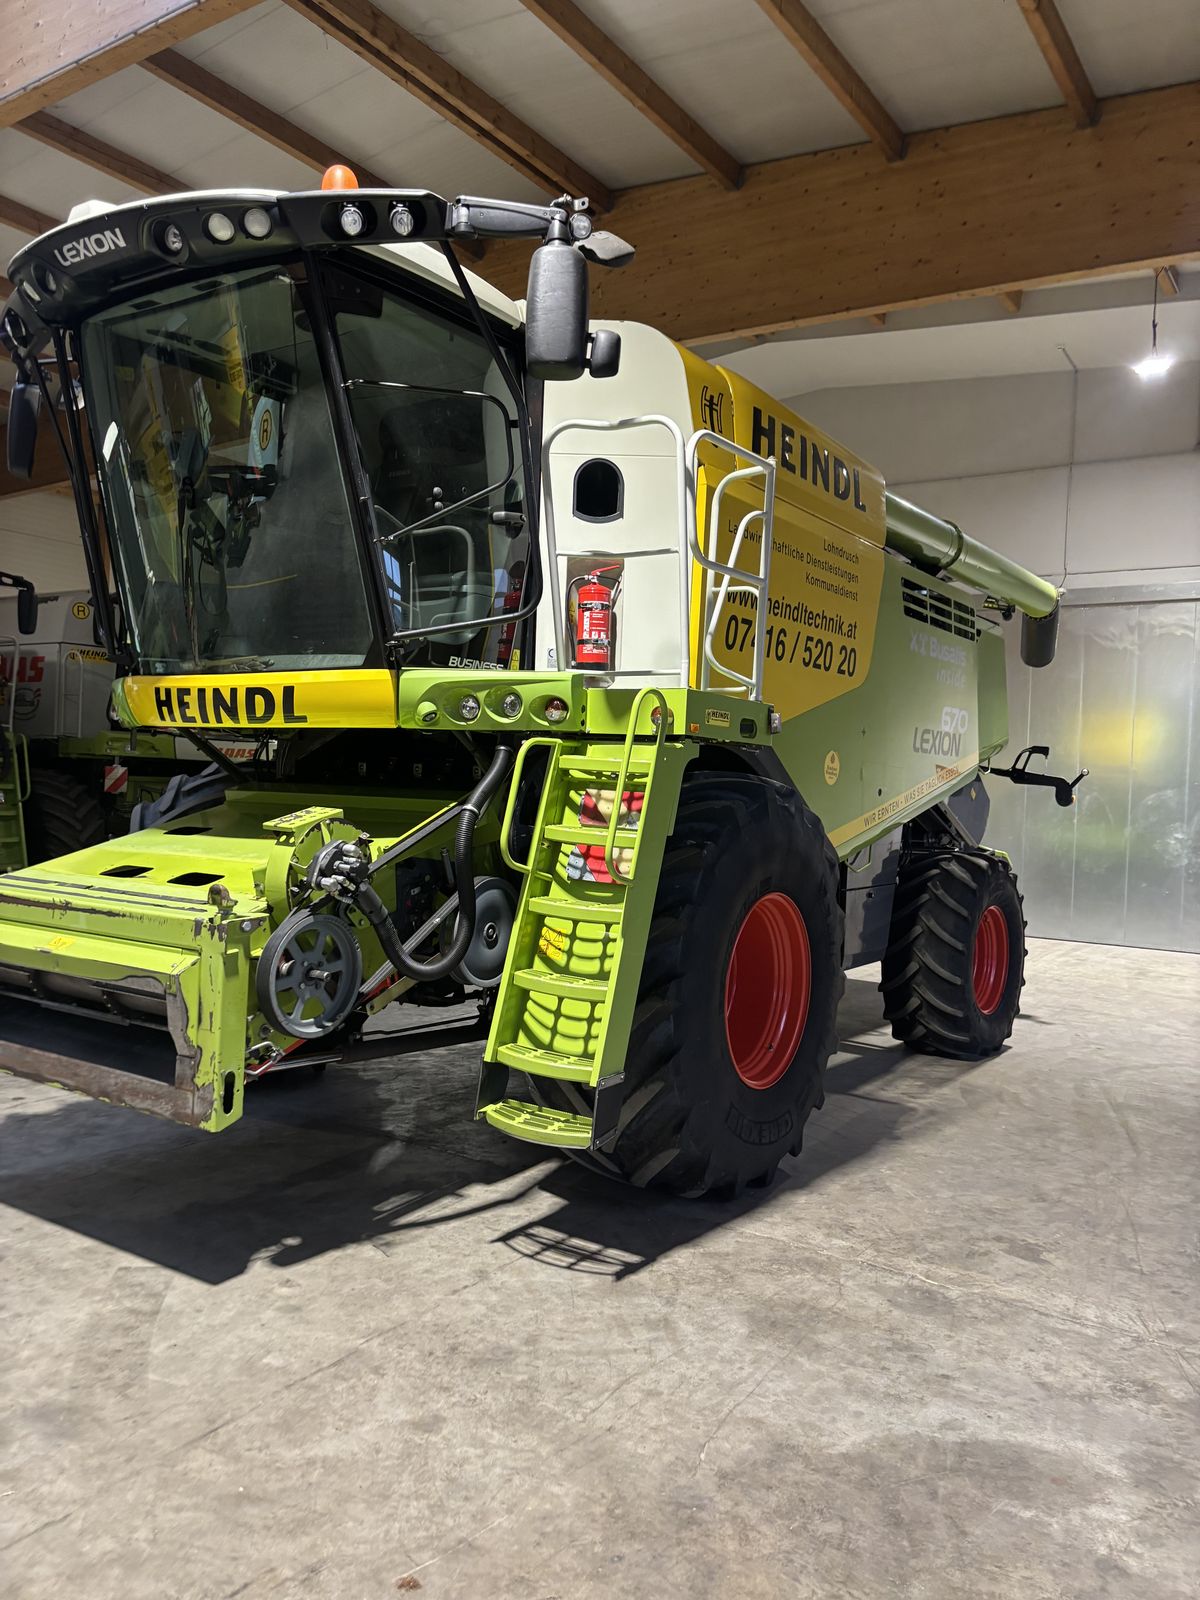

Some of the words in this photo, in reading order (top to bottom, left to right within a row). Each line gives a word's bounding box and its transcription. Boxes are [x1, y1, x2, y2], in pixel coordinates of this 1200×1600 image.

[54, 228, 126, 266] LEXION
[752, 406, 866, 512] HEINDL
[728, 520, 804, 561] Ladwirhaftliche
[806, 553, 859, 583] Dienstleistungen
[823, 539, 859, 564] Lohndrusch
[805, 572, 858, 602] Kommunaldienst
[77, 605, 86, 616] R
[727, 586, 857, 640] wwweindltechnik.at
[80, 649, 107, 658] HEIND
[449, 656, 504, 671] BUSINESS
[802, 636, 834, 672] 520
[837, 645, 857, 677] 20
[155, 686, 308, 724] HEINDL
[942, 706, 968, 734] 670
[913, 727, 961, 757] LEXION
[863, 812, 877, 827] WIR
[877, 800, 899, 820] ERNTEN
